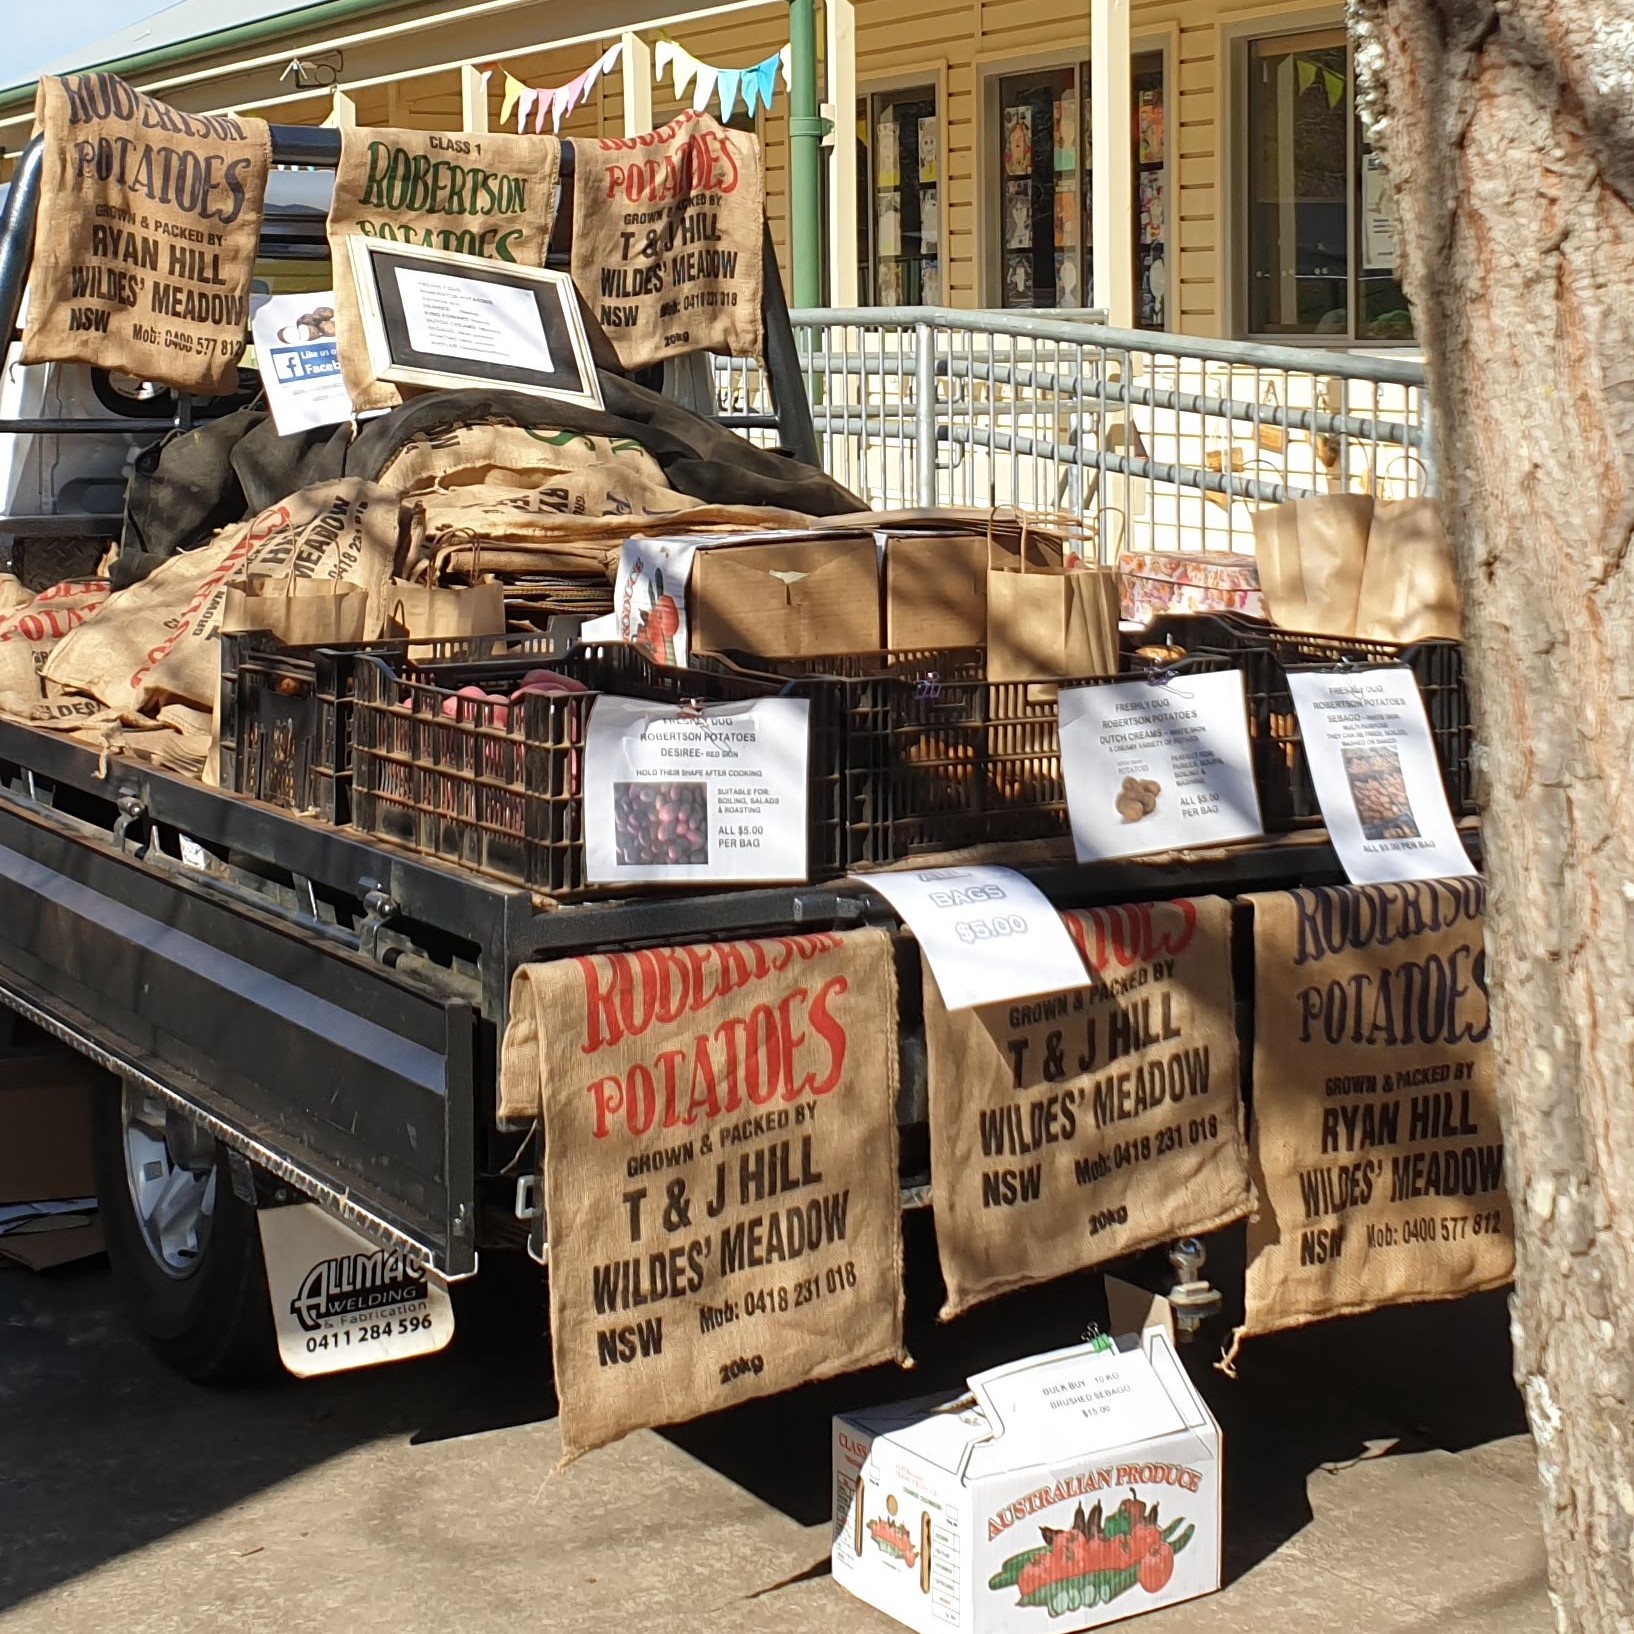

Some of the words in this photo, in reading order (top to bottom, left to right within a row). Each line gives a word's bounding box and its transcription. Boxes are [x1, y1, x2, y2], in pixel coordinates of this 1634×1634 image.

[429, 135, 471, 154] CLASS
[474, 143, 482, 156] 1
[74, 137, 252, 224] POTATOES
[358, 140, 529, 216] ROBERTSON
[605, 131, 739, 203] POTATOES
[95, 204, 136, 226] GROWN
[140, 215, 150, 230] &
[154, 219, 204, 244] PACKED
[207, 231, 223, 247] BY
[624, 209, 663, 225] GROWN
[708, 194, 723, 207] BY
[92, 224, 159, 271] RYAN
[168, 243, 227, 286] HILL
[620, 231, 636, 261] T
[641, 228, 659, 259] &
[680, 212, 722, 247] HILL
[671, 249, 739, 288] MEADOW
[72, 265, 145, 309] WILDES'
[151, 280, 244, 326] MEADOW
[69, 307, 112, 334] NSW
[164, 329, 194, 353] 0400
[195, 337, 218, 356] 577
[220, 339, 243, 357] 812
[600, 303, 640, 328] NSW
[664, 331, 690, 348] 20kg
[192, 590, 226, 637] GROWN
[1102, 716, 1151, 729] ROBERTSON
[1152, 709, 1198, 722] POTATOES
[1115, 701, 1150, 713] FRESHLY
[1312, 700, 1363, 710] ROBERTSON
[1363, 697, 1406, 707] POTATOES
[640, 732, 702, 742] ROBERTSON
[704, 732, 756, 742] POTATOES
[1099, 733, 1127, 745] DUTCH
[1127, 728, 1163, 741] CREAMS
[636, 769, 658, 777] HOLD
[660, 769, 680, 777] THEIR
[705, 769, 727, 777] AFTER
[717, 788, 752, 796] SUITABLE
[1180, 796, 1196, 806] ALL
[1182, 807, 1199, 818] PER
[719, 825, 736, 835] ALL
[738, 825, 763, 836] $5.00
[719, 838, 737, 848] PER
[739, 838, 760, 848] BAG
[929, 884, 1007, 909] BAGS
[954, 914, 1029, 945] $5.00
[1288, 875, 1488, 966] ROBERTSO
[1009, 997, 1068, 1029] GROWN
[1073, 990, 1084, 1011] &
[1153, 958, 1175, 982] BY
[1297, 944, 1491, 1046] POTATOES
[586, 974, 849, 1140] POTATOES
[1007, 1038, 1029, 1090] T
[1043, 1029, 1066, 1083] &
[1077, 1017, 1097, 1073] J
[1108, 991, 1182, 1063] HILL
[1325, 1075, 1377, 1098] GROWN
[1382, 1073, 1394, 1093] &
[1396, 1065, 1450, 1090] PACKED
[1454, 1062, 1474, 1081] BY
[979, 1087, 1085, 1157] WILDES'
[1093, 1045, 1210, 1130] MEADOW
[626, 1141, 694, 1178] GROWN
[700, 1134, 713, 1157] &
[720, 1113, 789, 1148] PACKED
[795, 1100, 817, 1123] BY
[1321, 1100, 1400, 1155] RYAN
[1408, 1089, 1478, 1143] HILL
[981, 1163, 1042, 1209] NSW
[1074, 1154, 1112, 1187] Mob:
[1113, 1139, 1151, 1170] 0418
[1157, 1124, 1183, 1156] 231
[1188, 1114, 1218, 1145] 018
[623, 1186, 647, 1242] T
[662, 1176, 693, 1233] &
[706, 1161, 726, 1219] J
[739, 1134, 823, 1205] HILL
[1300, 1159, 1382, 1219] WILDES'
[1390, 1144, 1504, 1203] MEADOW
[1366, 1222, 1398, 1249] Mob:
[1402, 1217, 1436, 1244] 0400
[1441, 1216, 1468, 1242] 577
[1472, 1210, 1501, 1235] 812
[593, 1234, 713, 1316] WILDES'
[720, 1189, 850, 1278] MEADOW
[323, 1319, 335, 1329] &
[340, 1301, 428, 1327] Fabrication
[328, 1286, 417, 1314] WELDING
[596, 1317, 663, 1367] NSW
[700, 1303, 740, 1335] Mob:
[744, 1286, 789, 1319] 0418
[794, 1276, 821, 1308] 231
[826, 1261, 857, 1295] 018
[306, 1331, 352, 1353] 0411
[358, 1321, 393, 1343] 284
[398, 1314, 433, 1335] 596
[719, 1354, 765, 1385] 20kg
[1042, 1383, 1067, 1396] BULK
[1068, 1380, 1086, 1390] BUY
[1094, 1375, 1105, 1385] 10
[1050, 1393, 1093, 1409] BRUSHED
[987, 1465, 1114, 1542] AUSTRALIAN
[1115, 1461, 1204, 1494] PRODUCE
